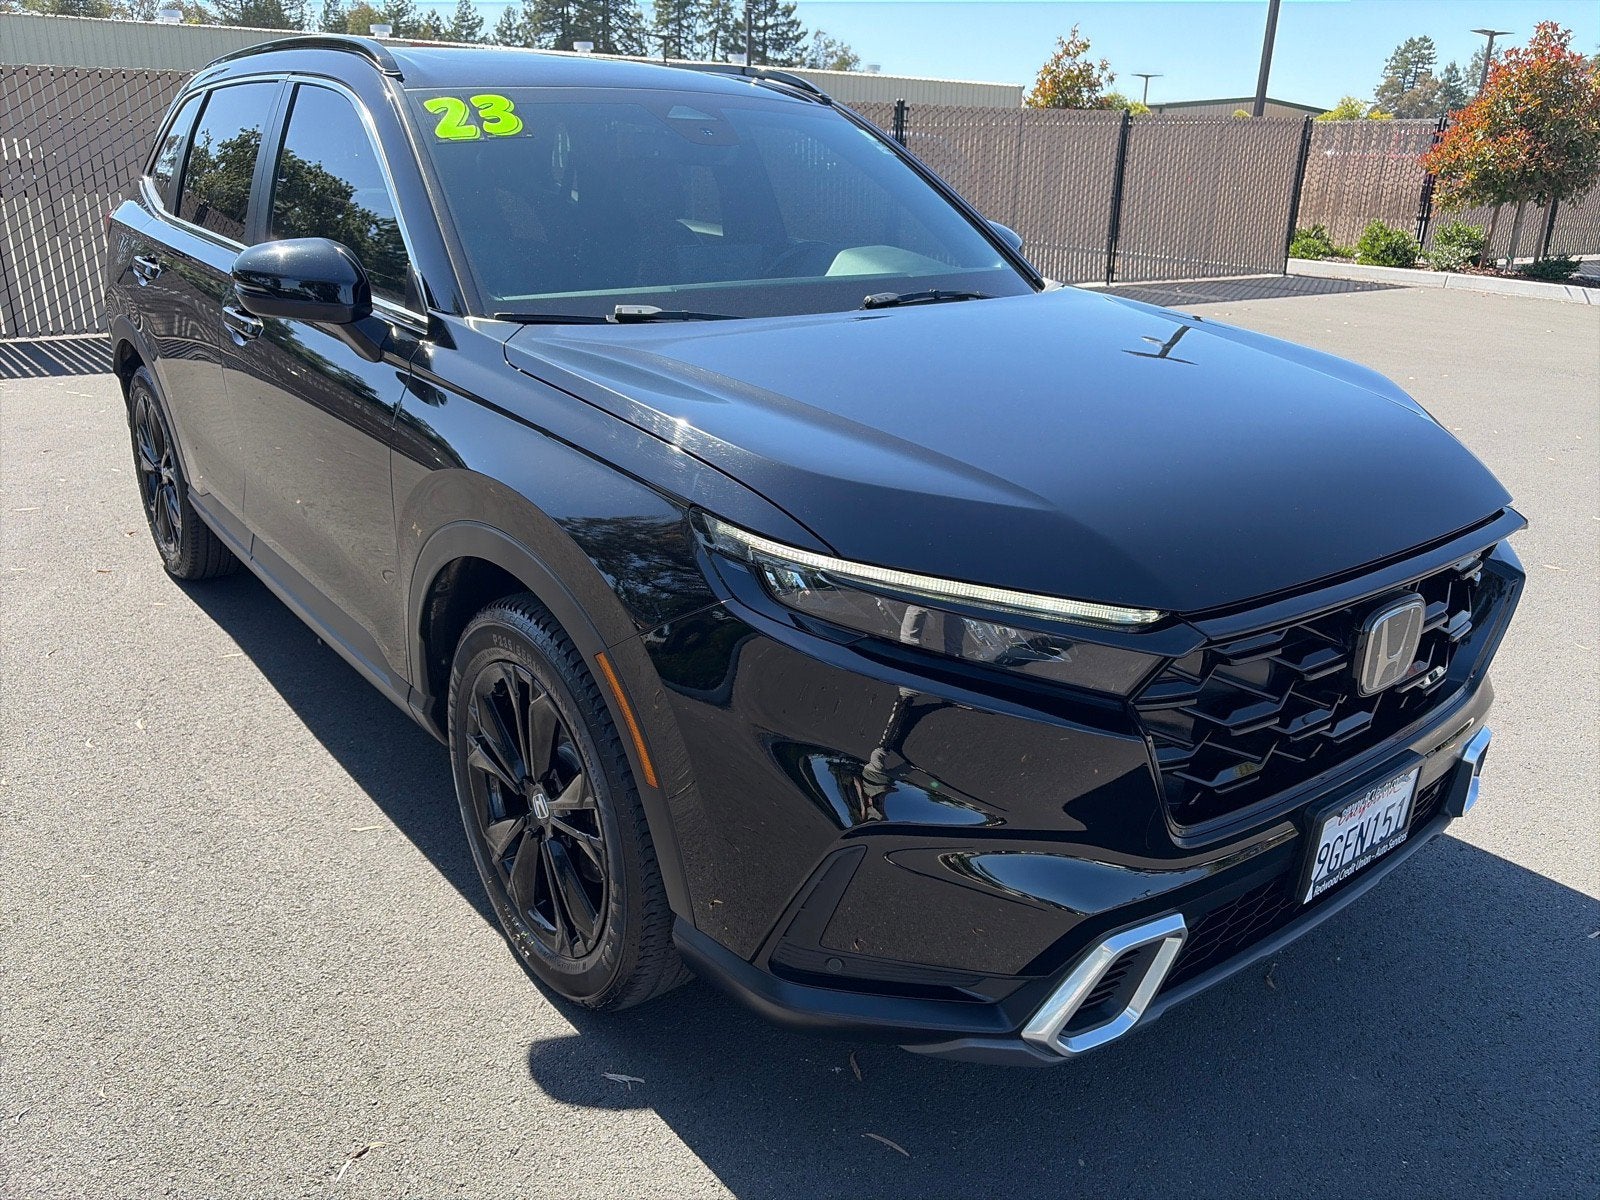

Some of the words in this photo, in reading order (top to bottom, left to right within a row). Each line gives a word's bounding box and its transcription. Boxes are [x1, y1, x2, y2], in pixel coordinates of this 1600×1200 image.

[423, 94, 523, 140] 23
[1313, 872, 1341, 897] Redwood
[1339, 863, 1356, 880] Credit
[1355, 854, 1371, 871] Union
[1376, 845, 1389, 856] Auto
[1388, 831, 1408, 850] Services
